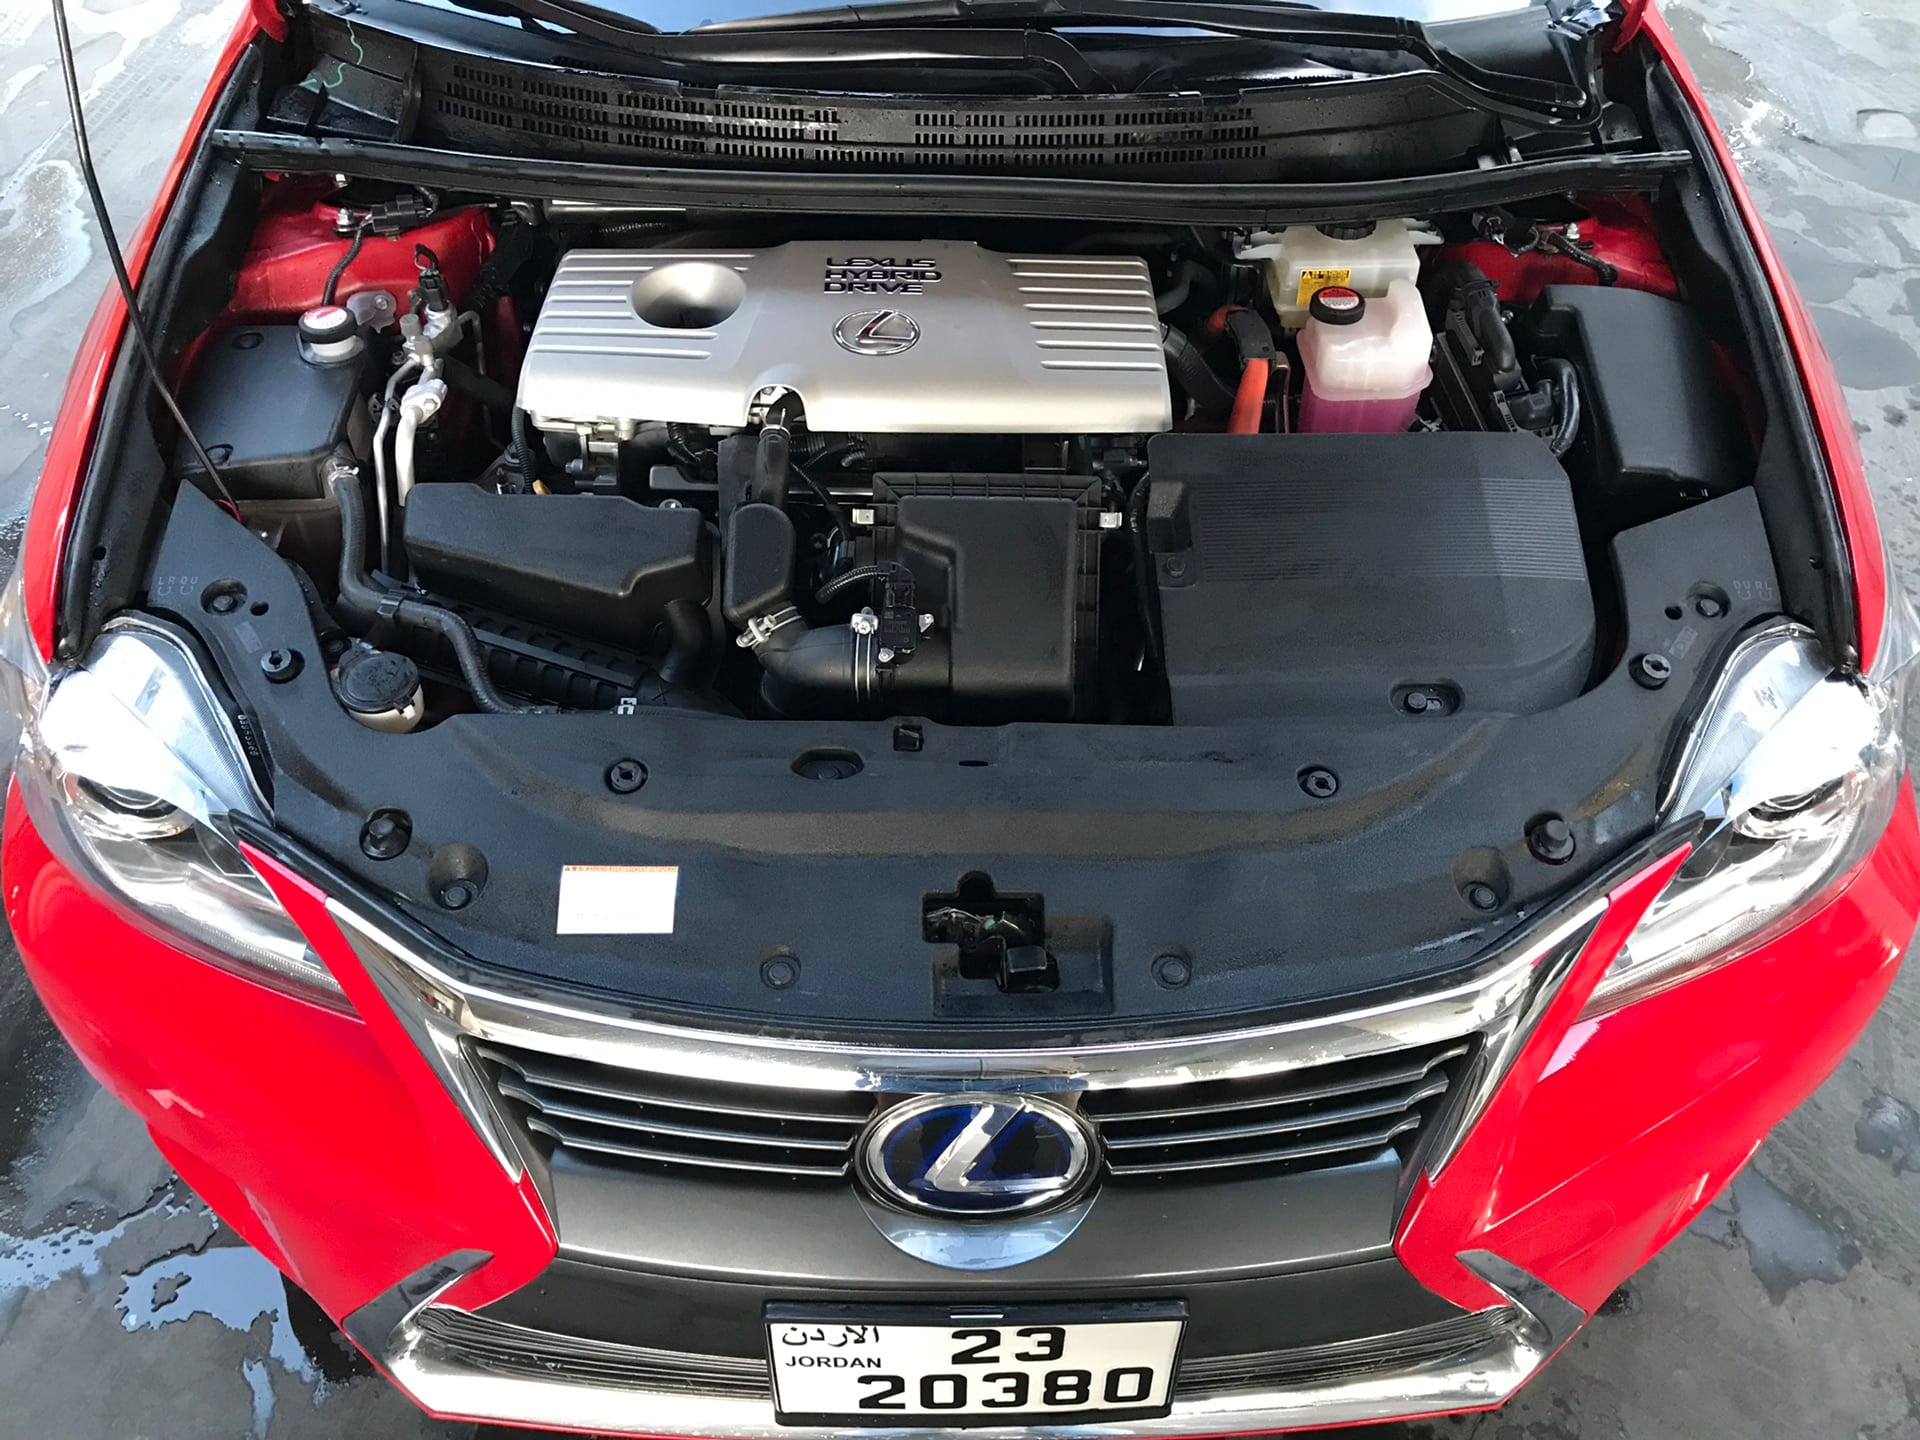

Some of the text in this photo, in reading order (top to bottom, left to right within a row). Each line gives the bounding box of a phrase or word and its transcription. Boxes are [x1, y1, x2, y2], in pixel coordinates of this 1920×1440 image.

[826, 257, 937, 269] LEXUS
[825, 269, 942, 282] HYBRID
[824, 281, 924, 294] DRIVE
[951, 1326, 1067, 1365] 23
[785, 1355, 882, 1369] JORDAN
[857, 1366, 1154, 1410] 20380
